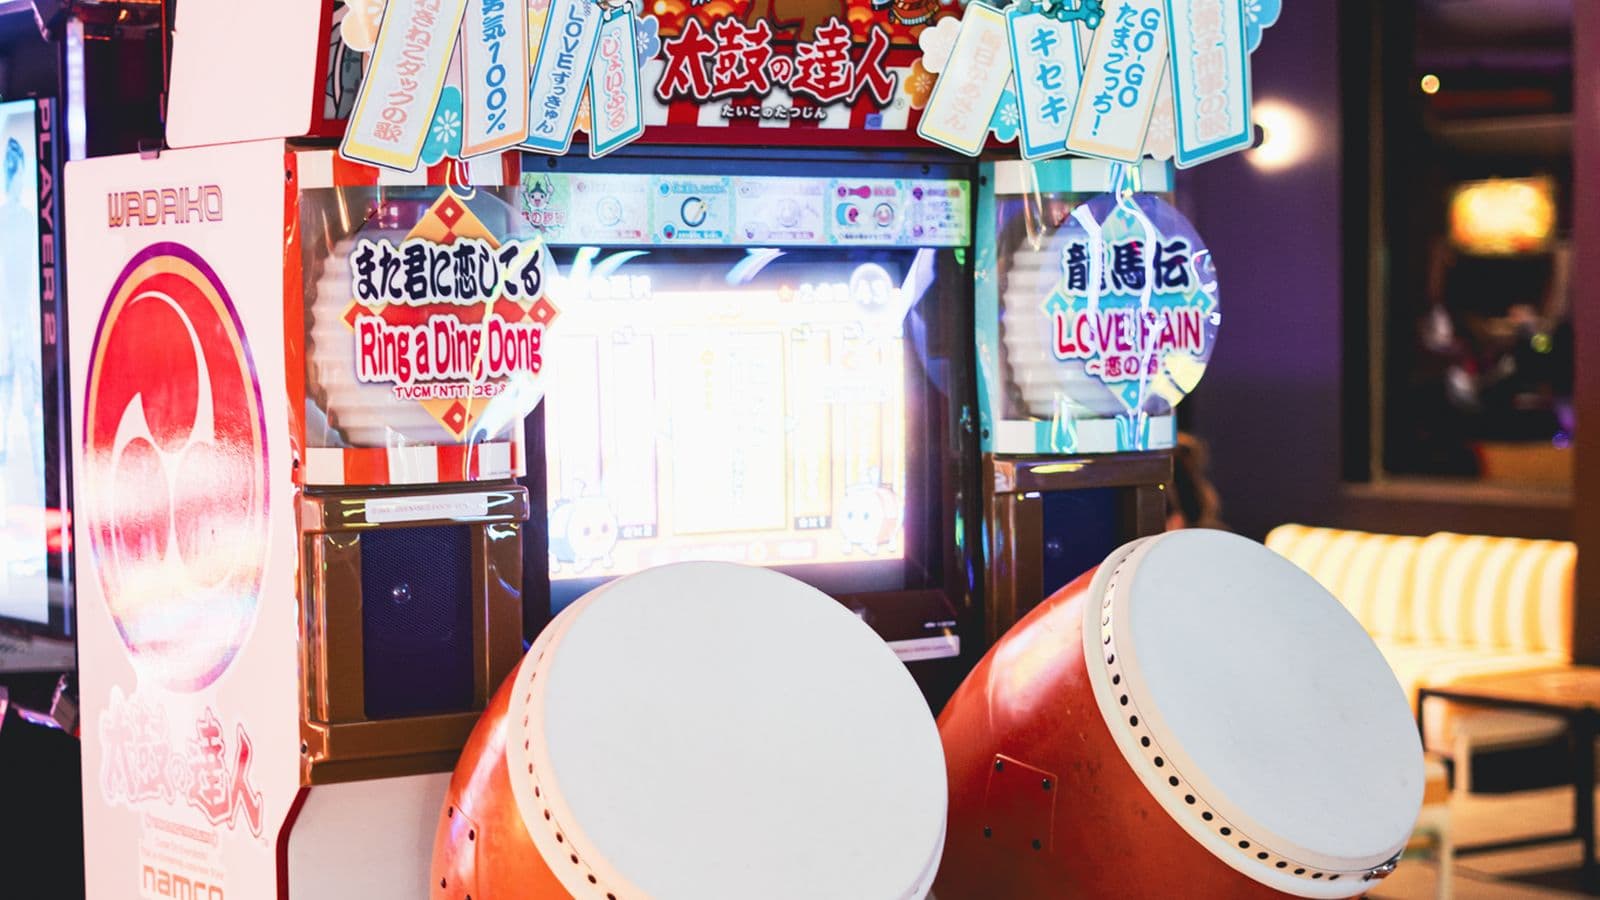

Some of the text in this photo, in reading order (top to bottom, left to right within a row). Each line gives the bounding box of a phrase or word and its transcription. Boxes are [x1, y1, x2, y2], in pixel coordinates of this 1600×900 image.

[656, 17, 899, 104] 太鼓の達人
[1030, 27, 1068, 124] キセキ
[1117, 7, 1161, 108] GO-GO
[721, 104, 827, 120] たいこのたつじん
[38, 98, 57, 345] PLAYER 2
[108, 184, 223, 228] WADAIKO
[355, 242, 542, 300] また君に恋してる
[360, 318, 543, 383] Ring a Ding Dong
[1056, 311, 1132, 354] LOVE
